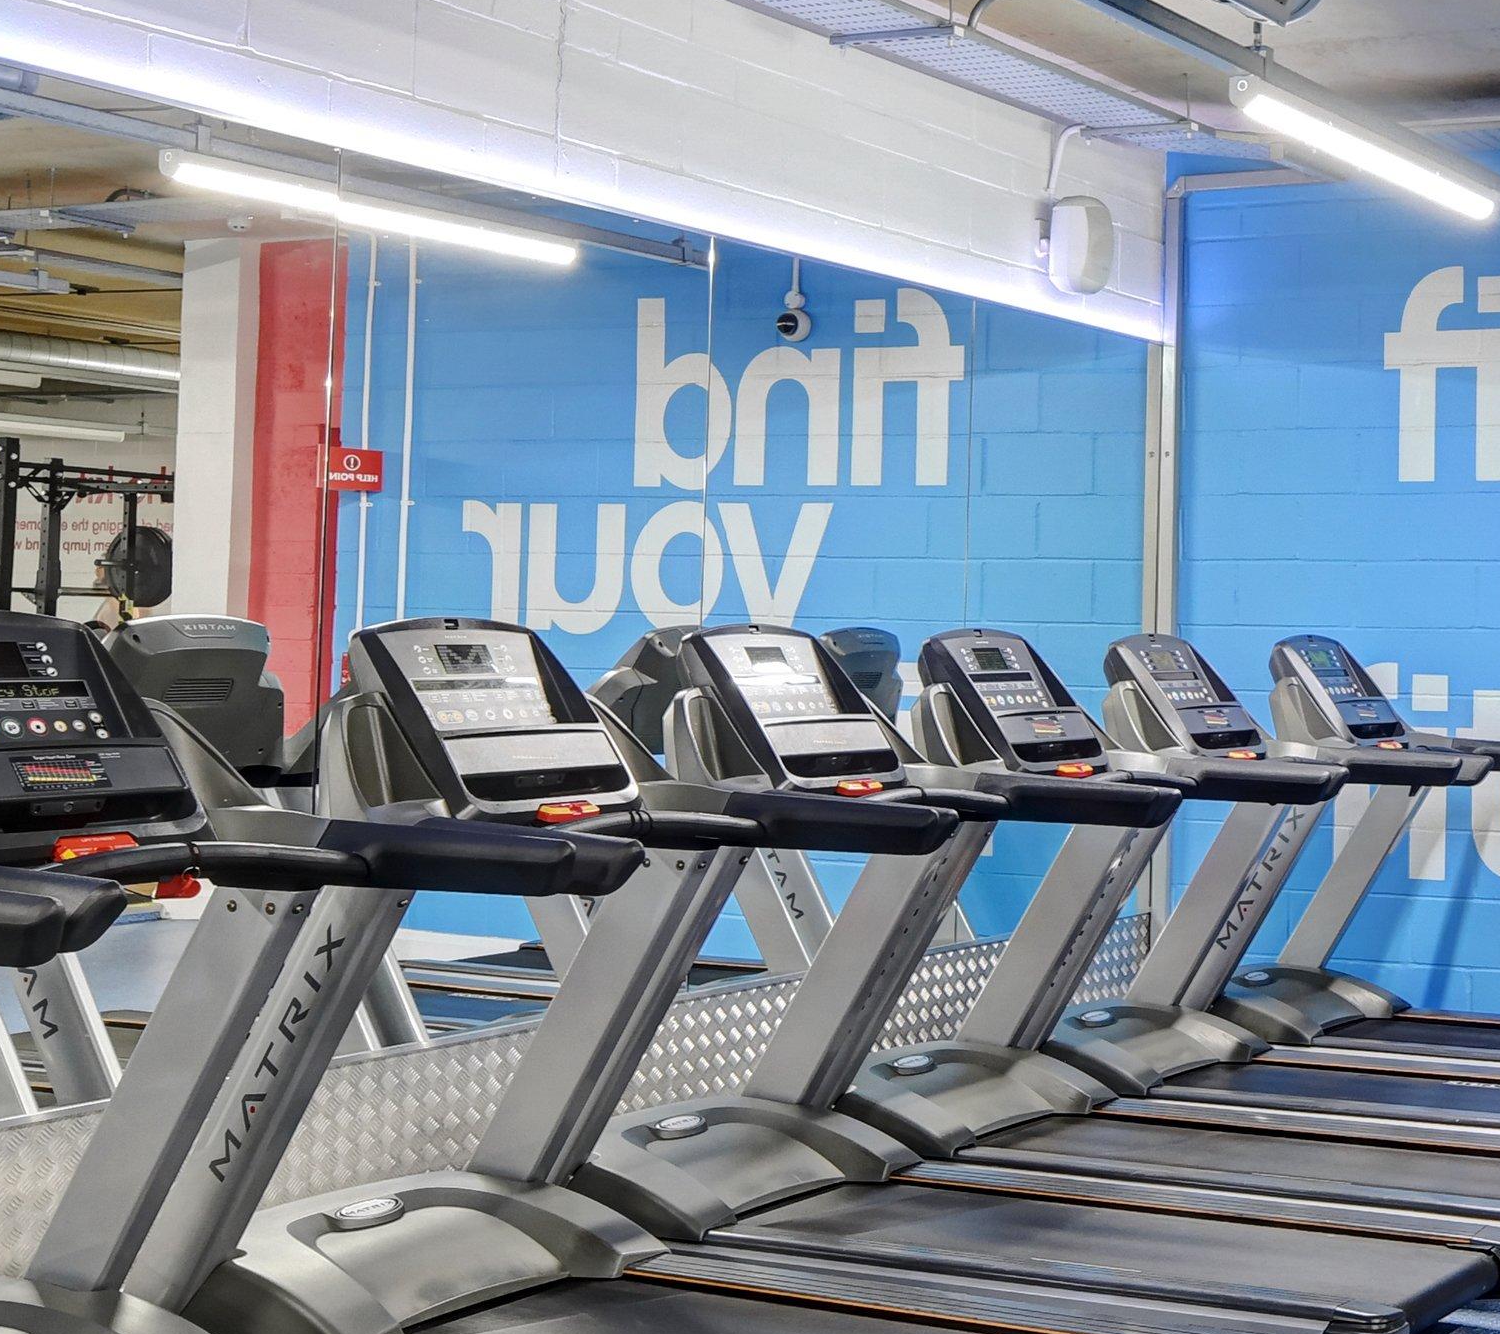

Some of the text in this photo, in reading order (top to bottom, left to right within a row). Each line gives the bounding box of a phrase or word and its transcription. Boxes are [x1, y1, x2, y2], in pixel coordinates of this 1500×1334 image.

[1215, 805, 1306, 951] MATRIX
[208, 924, 348, 1185] MATRIX
[345, 1200, 393, 1217] MATRIX
